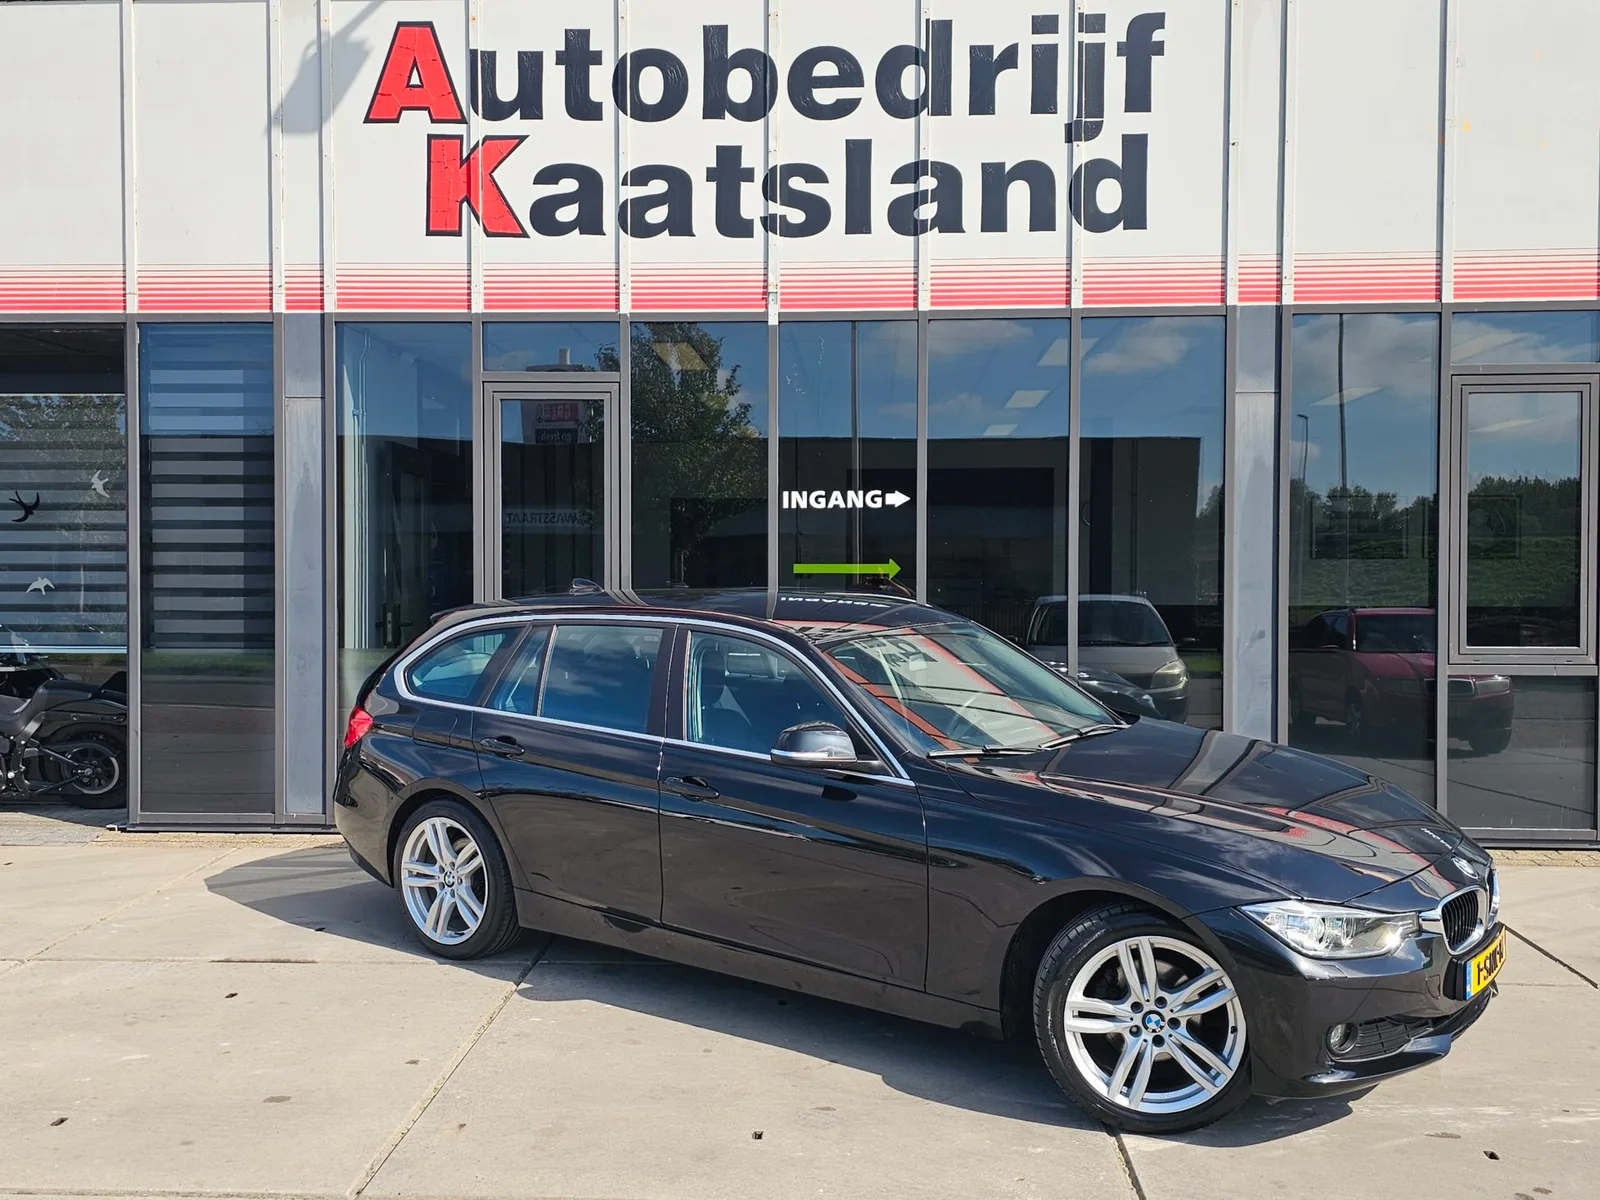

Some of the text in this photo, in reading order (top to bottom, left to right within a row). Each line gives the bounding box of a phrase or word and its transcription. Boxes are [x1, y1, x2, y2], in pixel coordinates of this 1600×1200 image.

[363, 12, 1166, 143] Autobedrijf
[425, 133, 1149, 238] Kaatsland
[782, 490, 883, 509] INGANG
